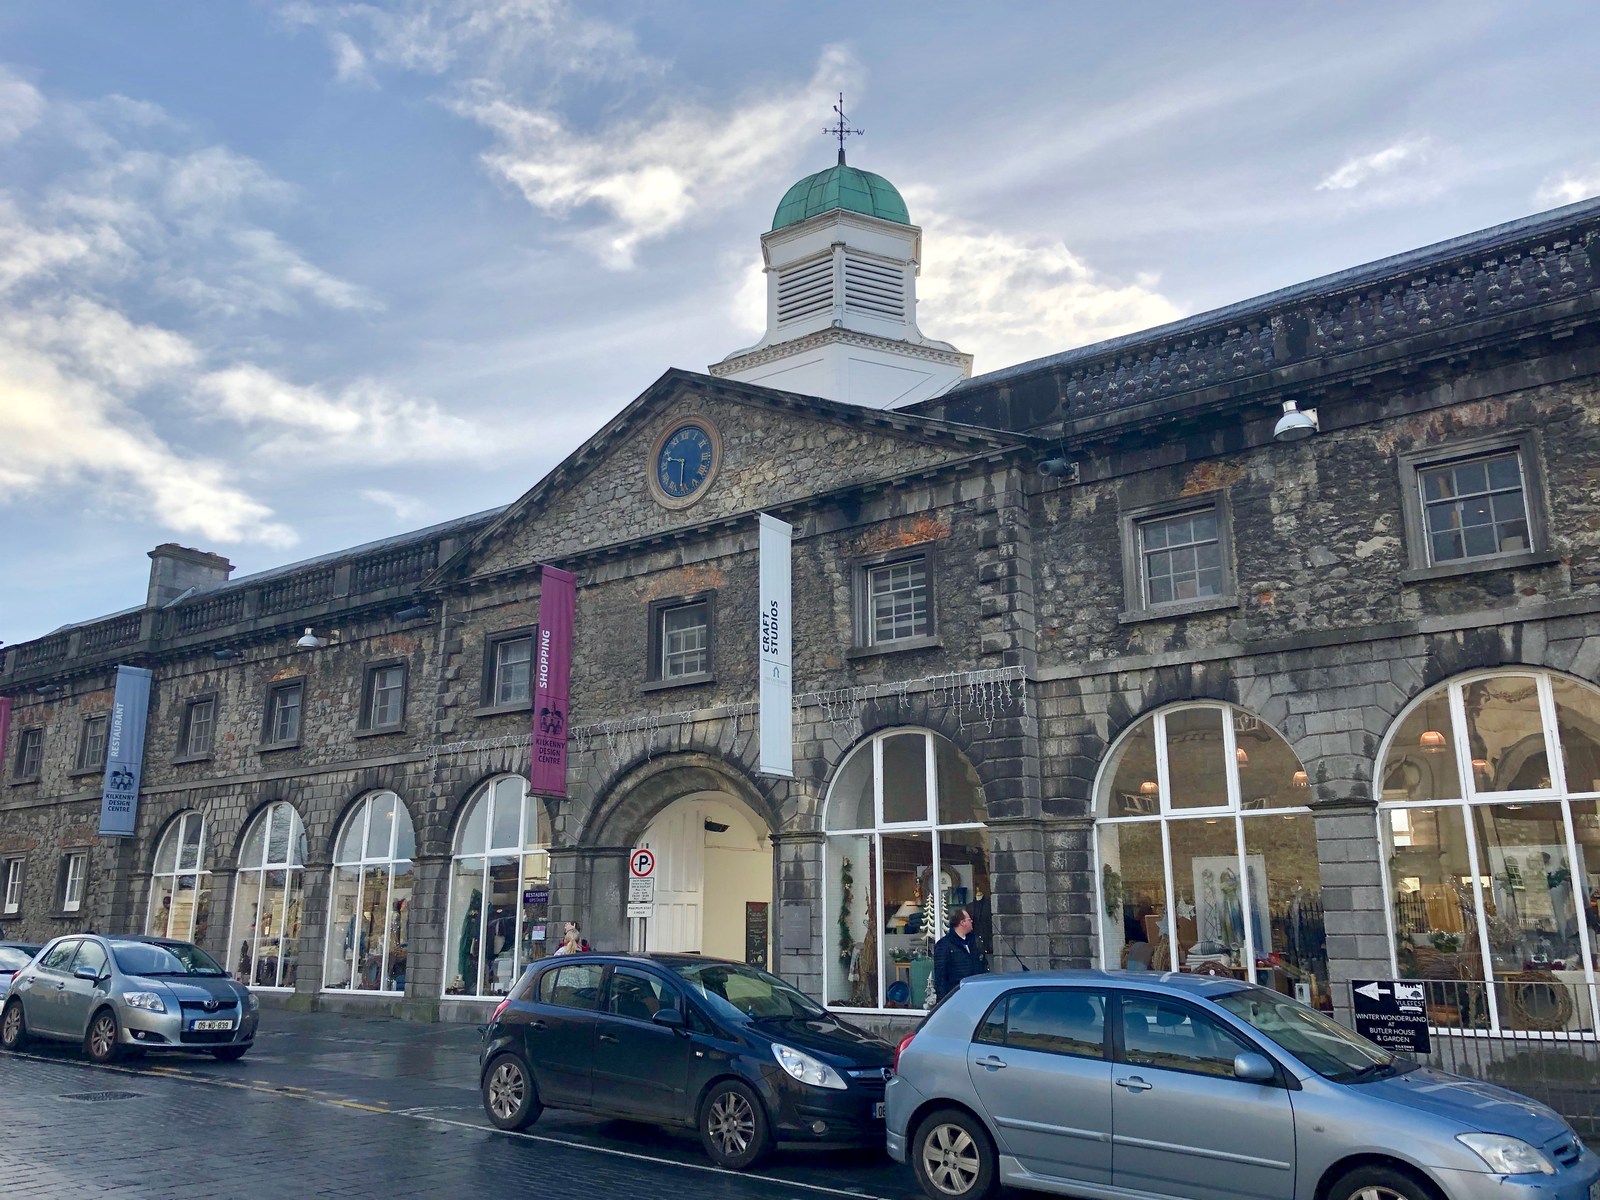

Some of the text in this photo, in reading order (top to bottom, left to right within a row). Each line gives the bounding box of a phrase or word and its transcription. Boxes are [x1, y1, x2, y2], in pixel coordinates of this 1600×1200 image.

[540, 630, 550, 688] SHOPPING
[110, 702, 124, 758] RESTAURANT
[536, 737, 566, 750] KILKENNY
[538, 747, 561, 756] DESIGN
[538, 756, 561, 765] CENTRE
[106, 793, 135, 801] KILKENNY
[638, 855, 648, 872] P
